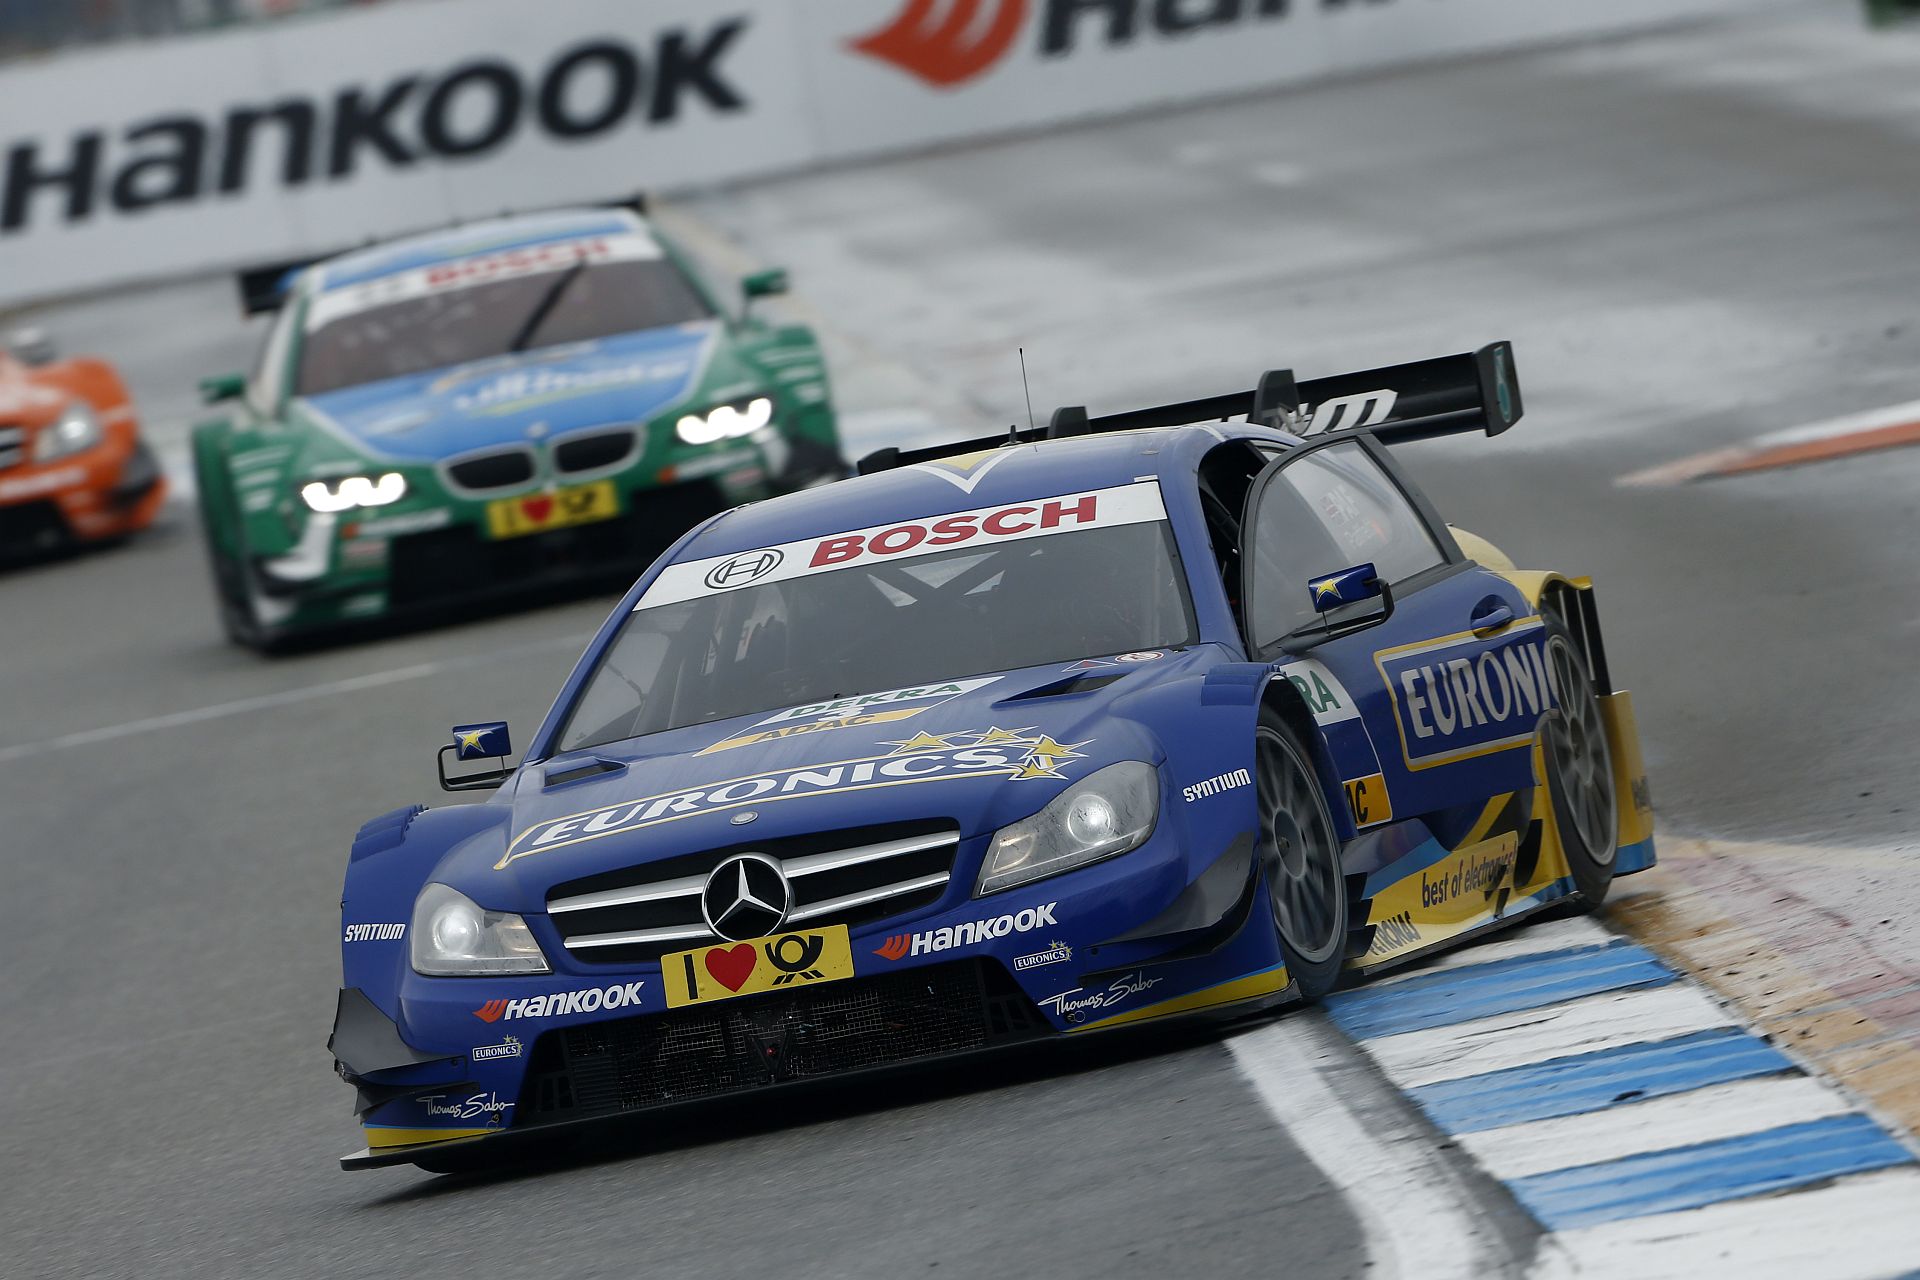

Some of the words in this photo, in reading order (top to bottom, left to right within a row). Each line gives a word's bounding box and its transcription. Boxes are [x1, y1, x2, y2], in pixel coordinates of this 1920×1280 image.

[809, 495, 1098, 568] BOSCH
[788, 684, 963, 718] DEKRA
[751, 714, 876, 743] ADAC
[532, 747, 1010, 846] EURONICS
[1421, 872, 1450, 908] best
[1451, 858, 1464, 898] of
[344, 923, 406, 943] SYNTIUM
[1017, 949, 1066, 968] EURONICS
[683, 954, 698, 1001] I
[1037, 987, 1104, 1016] Thomas
[1103, 970, 1163, 1008] Sabo
[475, 1045, 517, 1059] EURONICS
[416, 1095, 463, 1118] Thomas
[460, 1091, 516, 1119] Sabo
